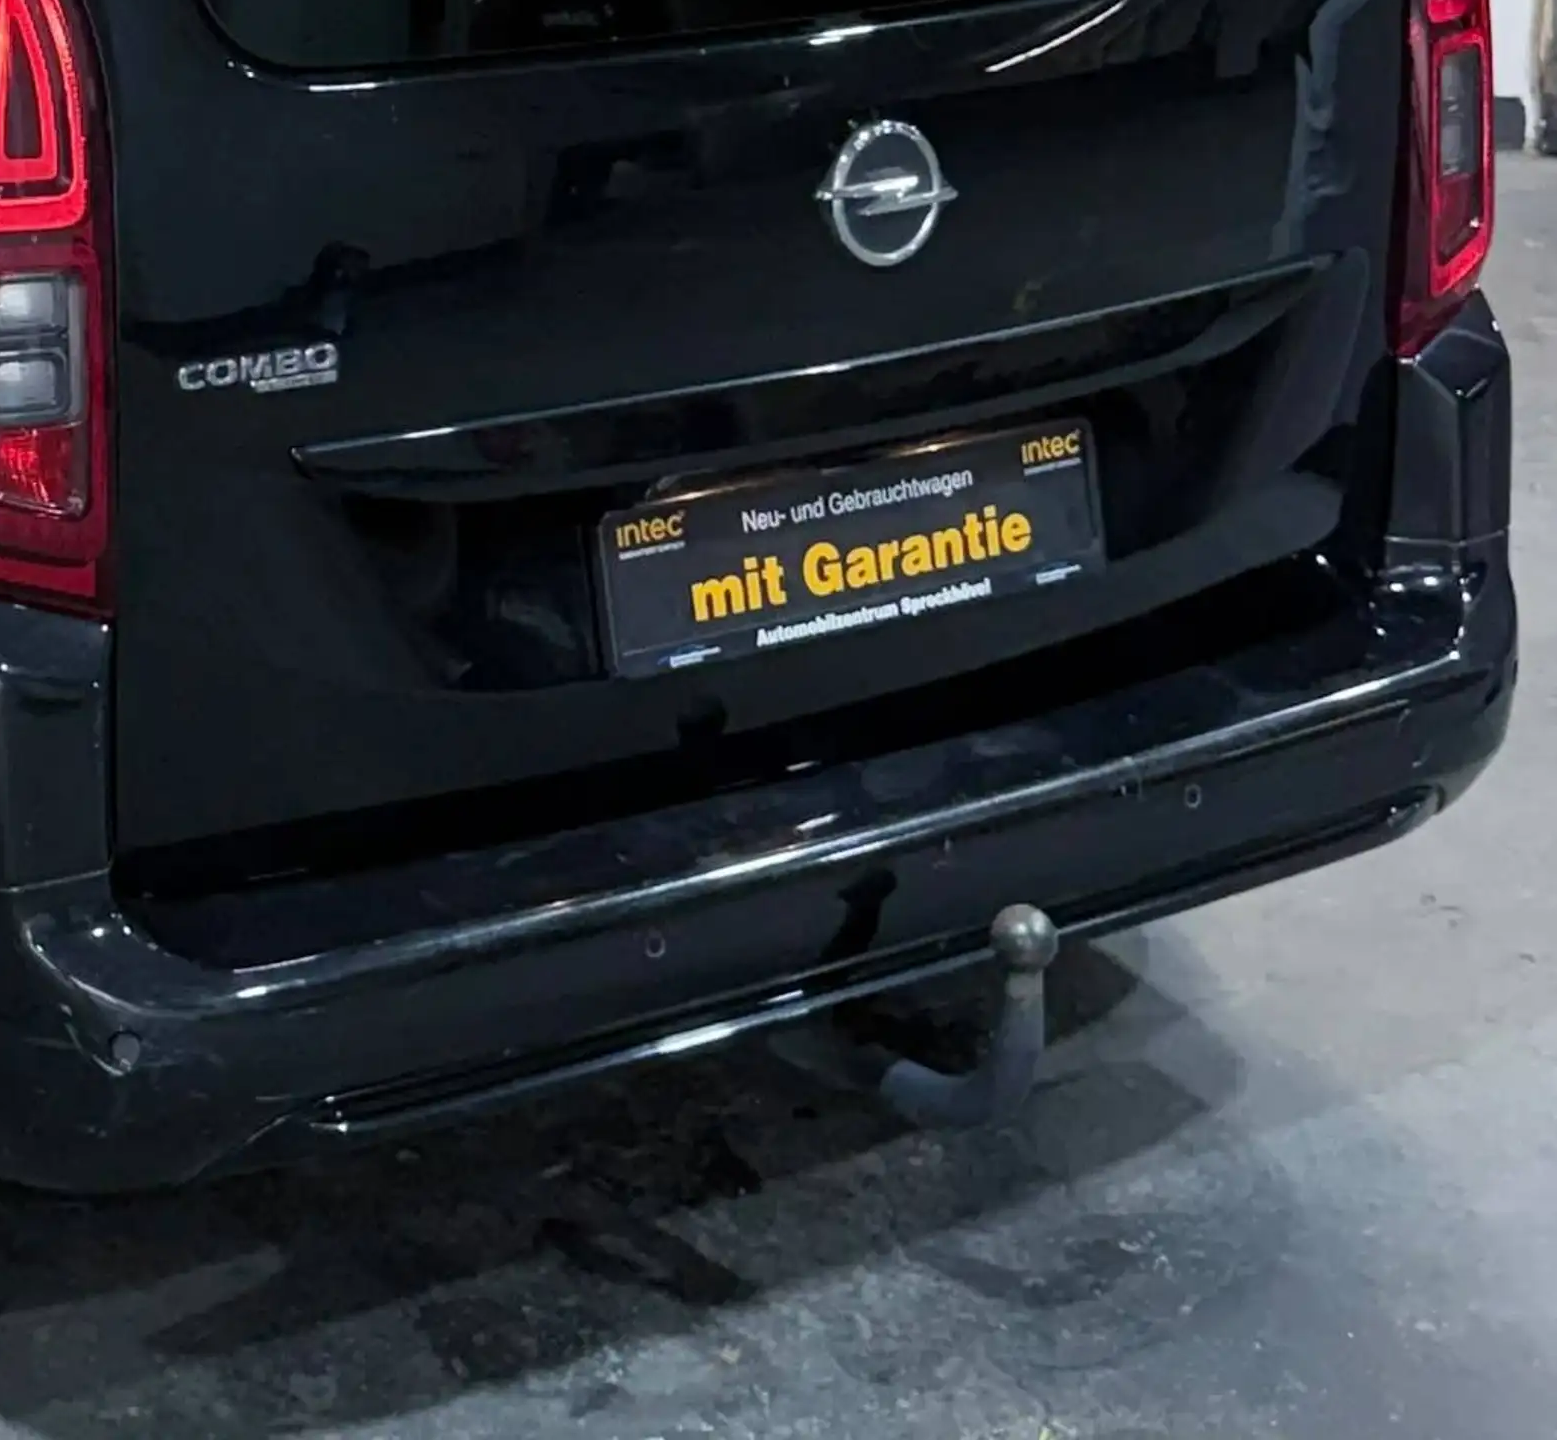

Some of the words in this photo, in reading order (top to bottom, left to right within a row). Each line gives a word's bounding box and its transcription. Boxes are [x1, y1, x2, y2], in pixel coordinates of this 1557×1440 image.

[178, 343, 339, 390] COMBO
[1021, 430, 1081, 465] intec
[742, 510, 786, 533] Neu-
[791, 496, 825, 524] und
[828, 469, 973, 514] Gebrauchtwagen
[616, 511, 684, 548] intec
[691, 556, 786, 622] mit
[803, 505, 1033, 597] Garantie
[756, 602, 899, 647] Automobilzentrum
